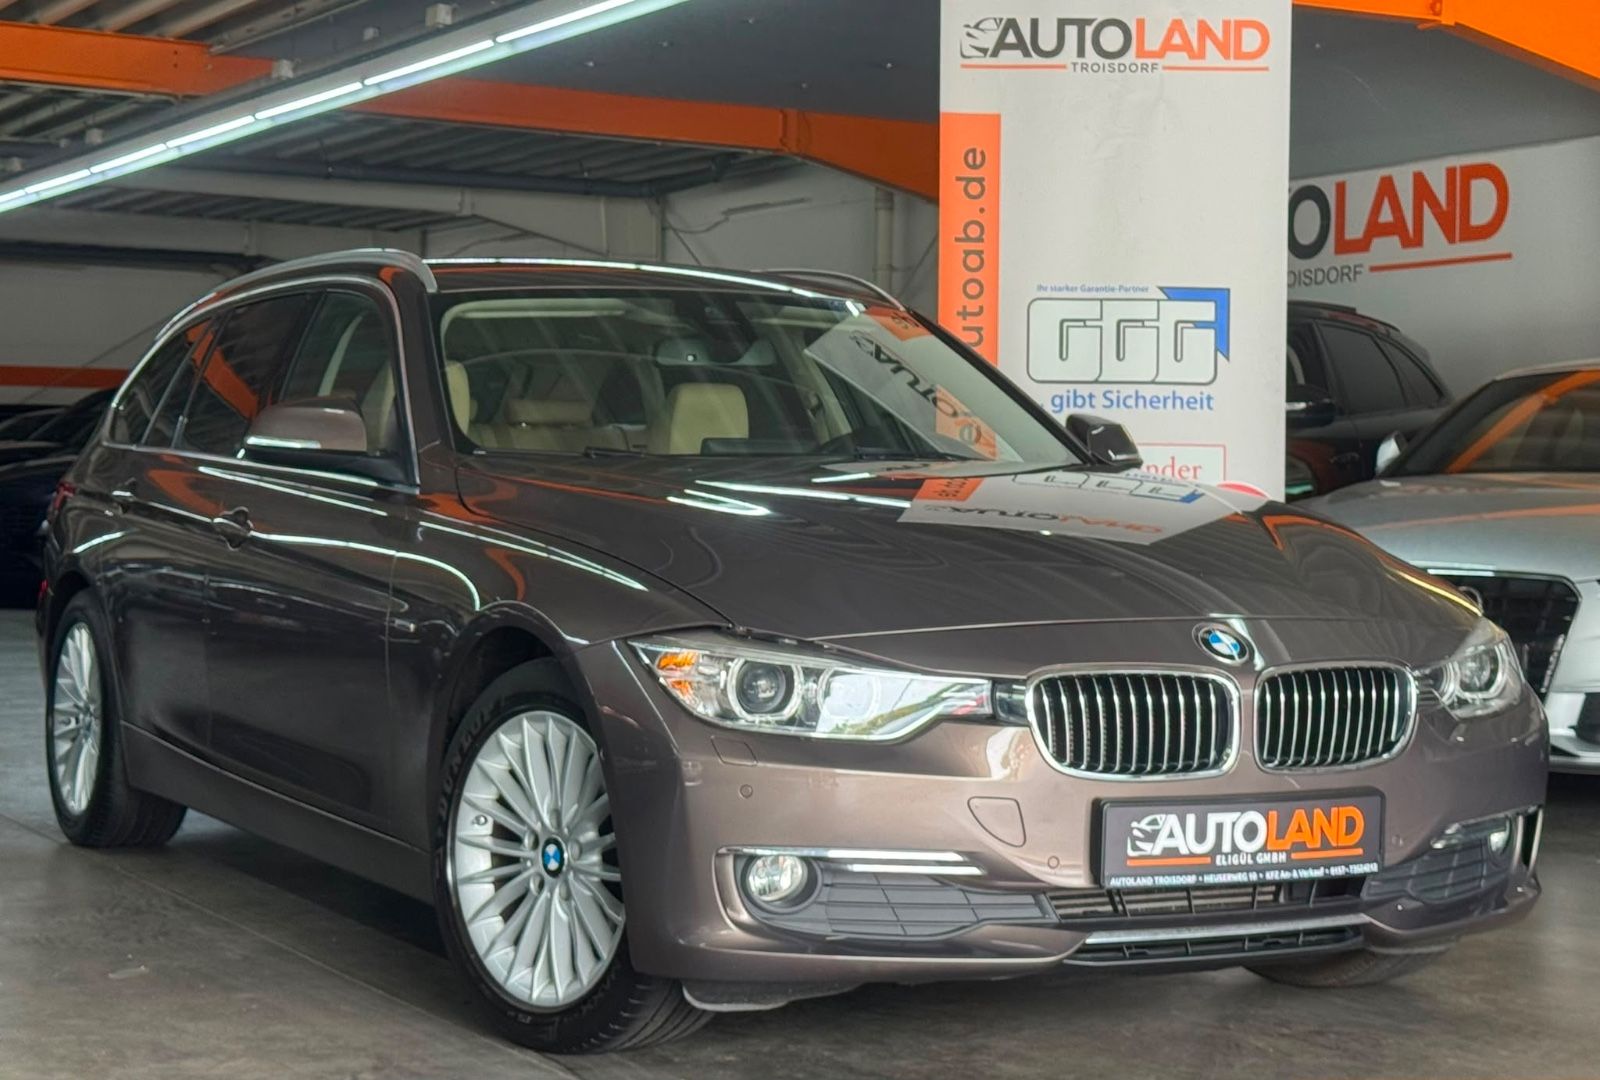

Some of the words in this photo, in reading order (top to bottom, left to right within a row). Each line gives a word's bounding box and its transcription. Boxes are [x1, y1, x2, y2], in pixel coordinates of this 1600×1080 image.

[989, 17, 1271, 60] AUTOLAND
[1071, 61, 1159, 73] TROISDORF
[1288, 162, 1510, 260] OLAND
[955, 147, 987, 347] utoab.de
[1287, 264, 1364, 288] OISDORF
[1051, 388, 1096, 414] gibt
[1102, 389, 1215, 411] Sicherheit
[1146, 455, 1202, 480] nder
[1151, 805, 1365, 856] AUTOLAND
[1256, 851, 1287, 865] GMBH
